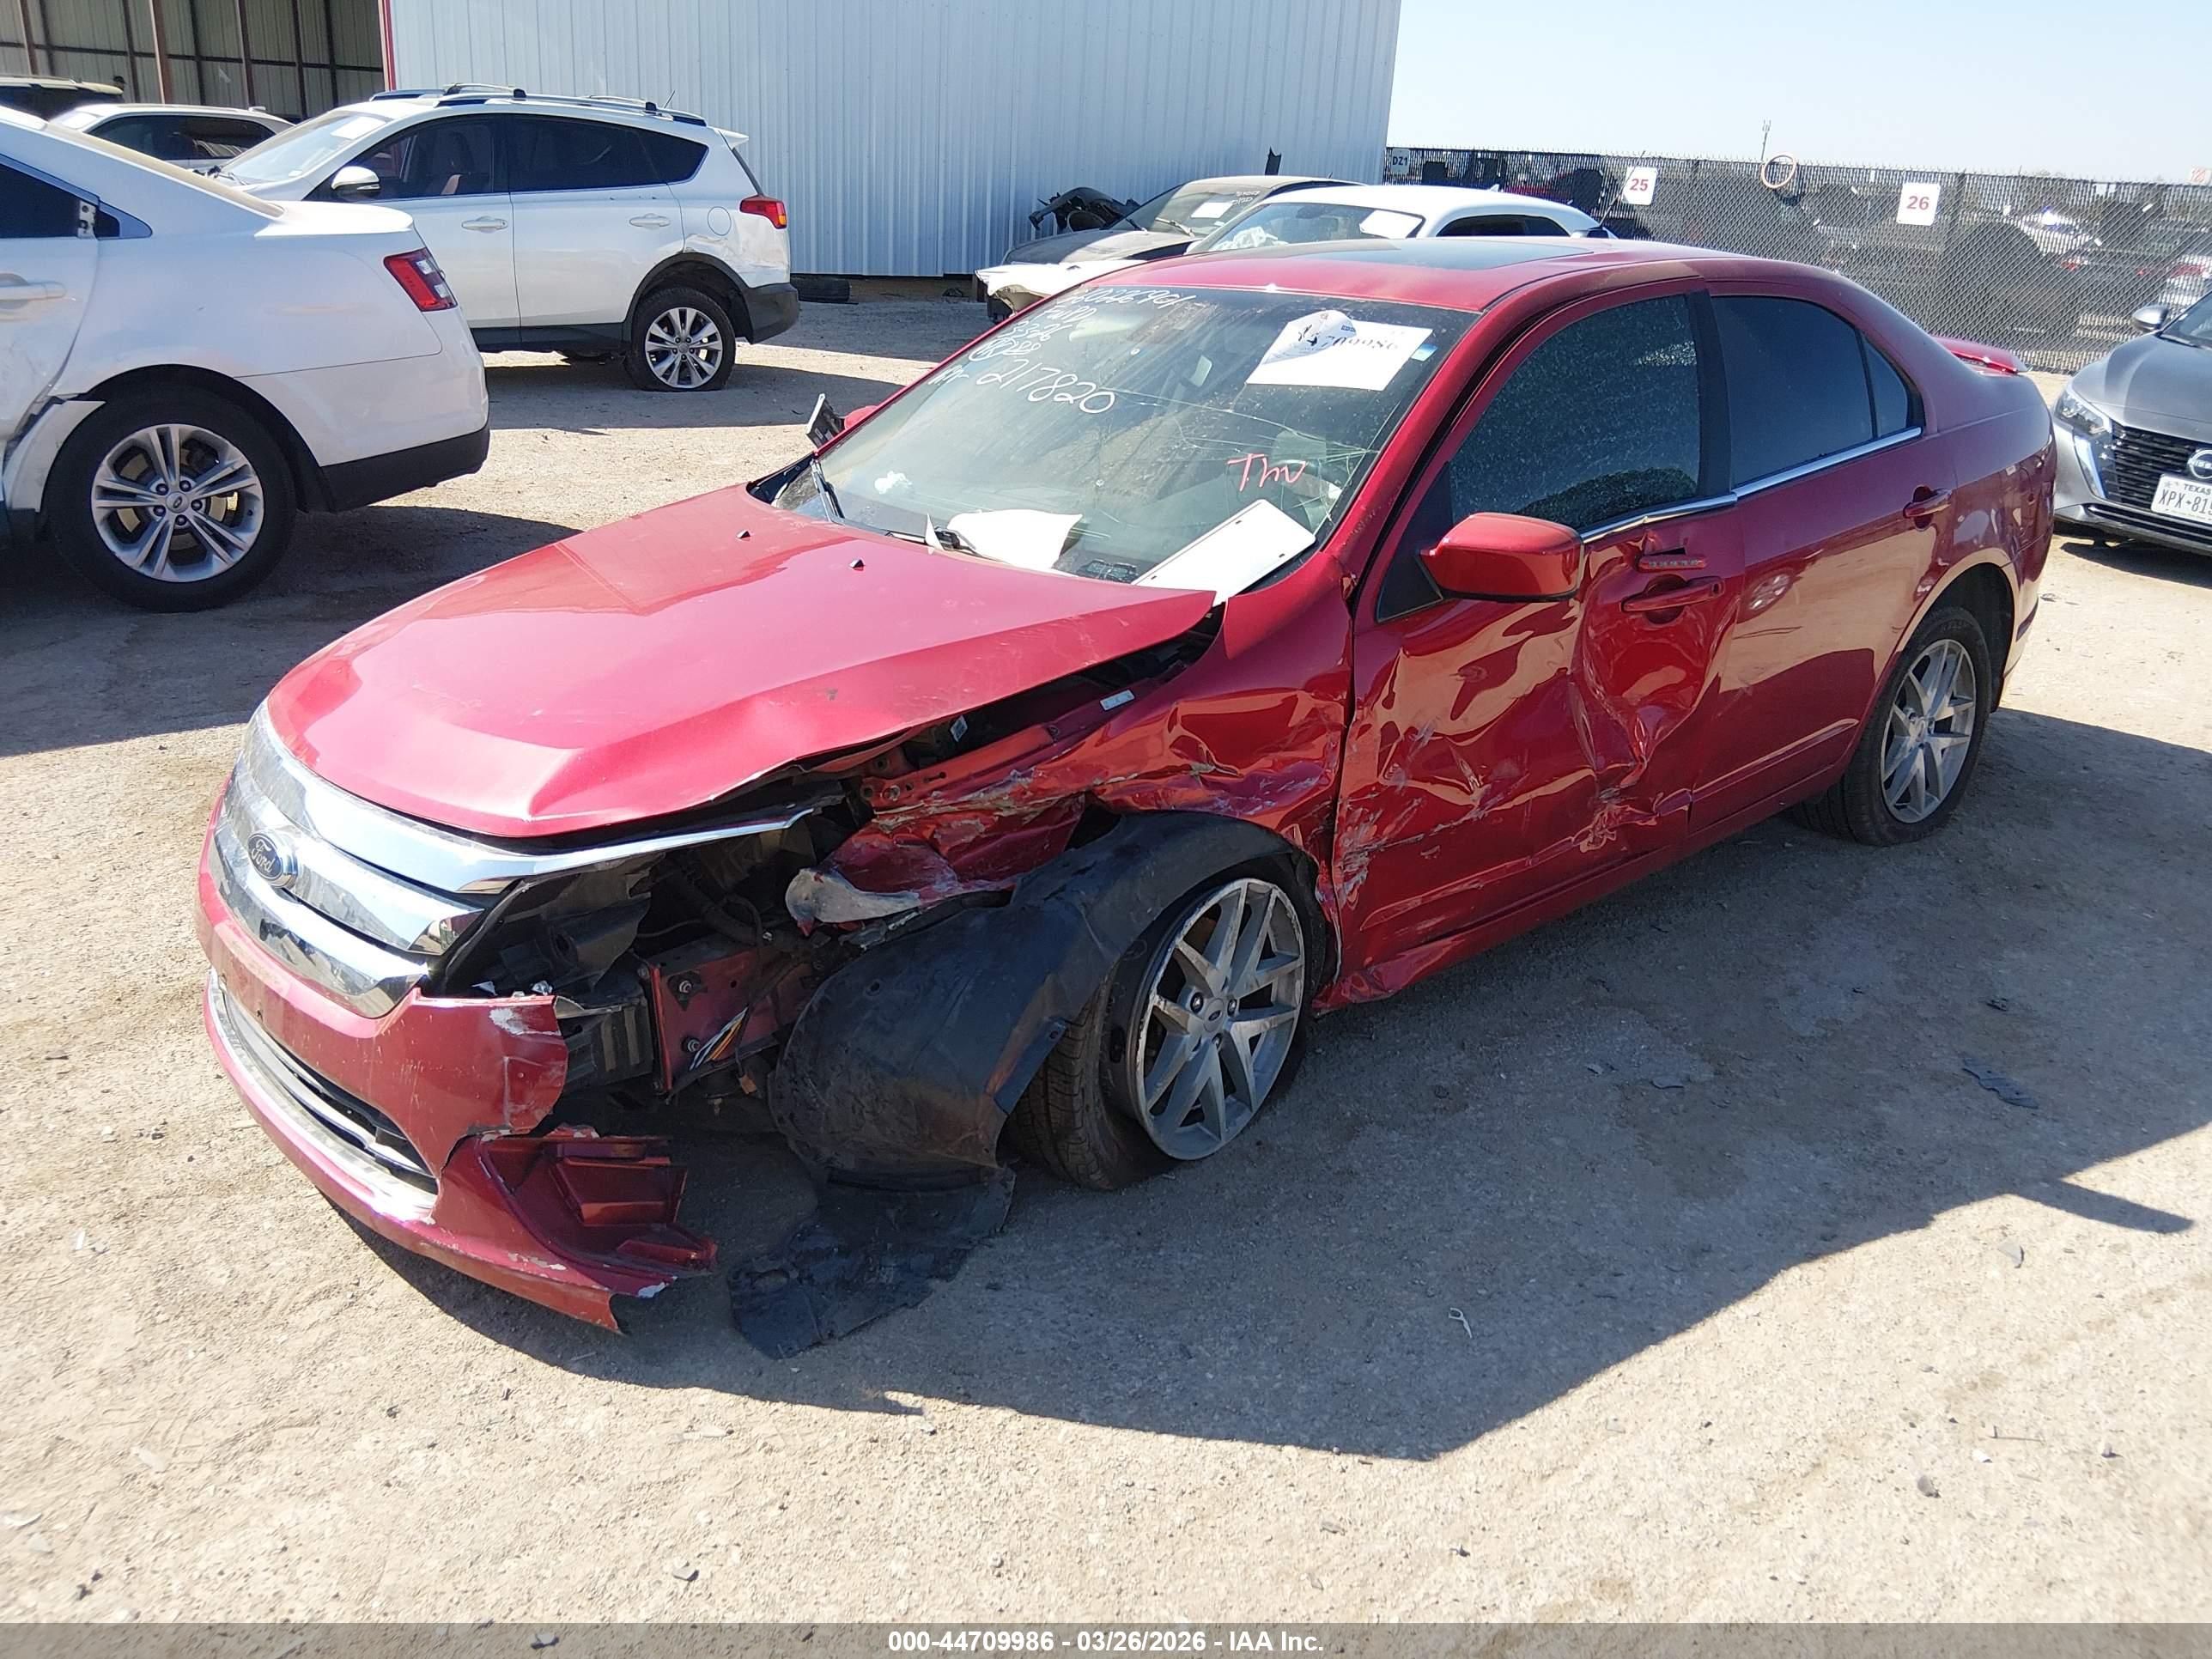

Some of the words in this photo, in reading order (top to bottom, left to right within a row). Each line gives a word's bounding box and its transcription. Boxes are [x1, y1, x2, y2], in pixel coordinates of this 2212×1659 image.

[1392, 155, 1408, 166] DZ1
[1629, 178, 1649, 191] 25
[1906, 195, 1929, 210] 26
[976, 359, 1115, 414] 217820
[2184, 483, 2211, 495] TEXAS
[251, 839, 276, 873] Ford
